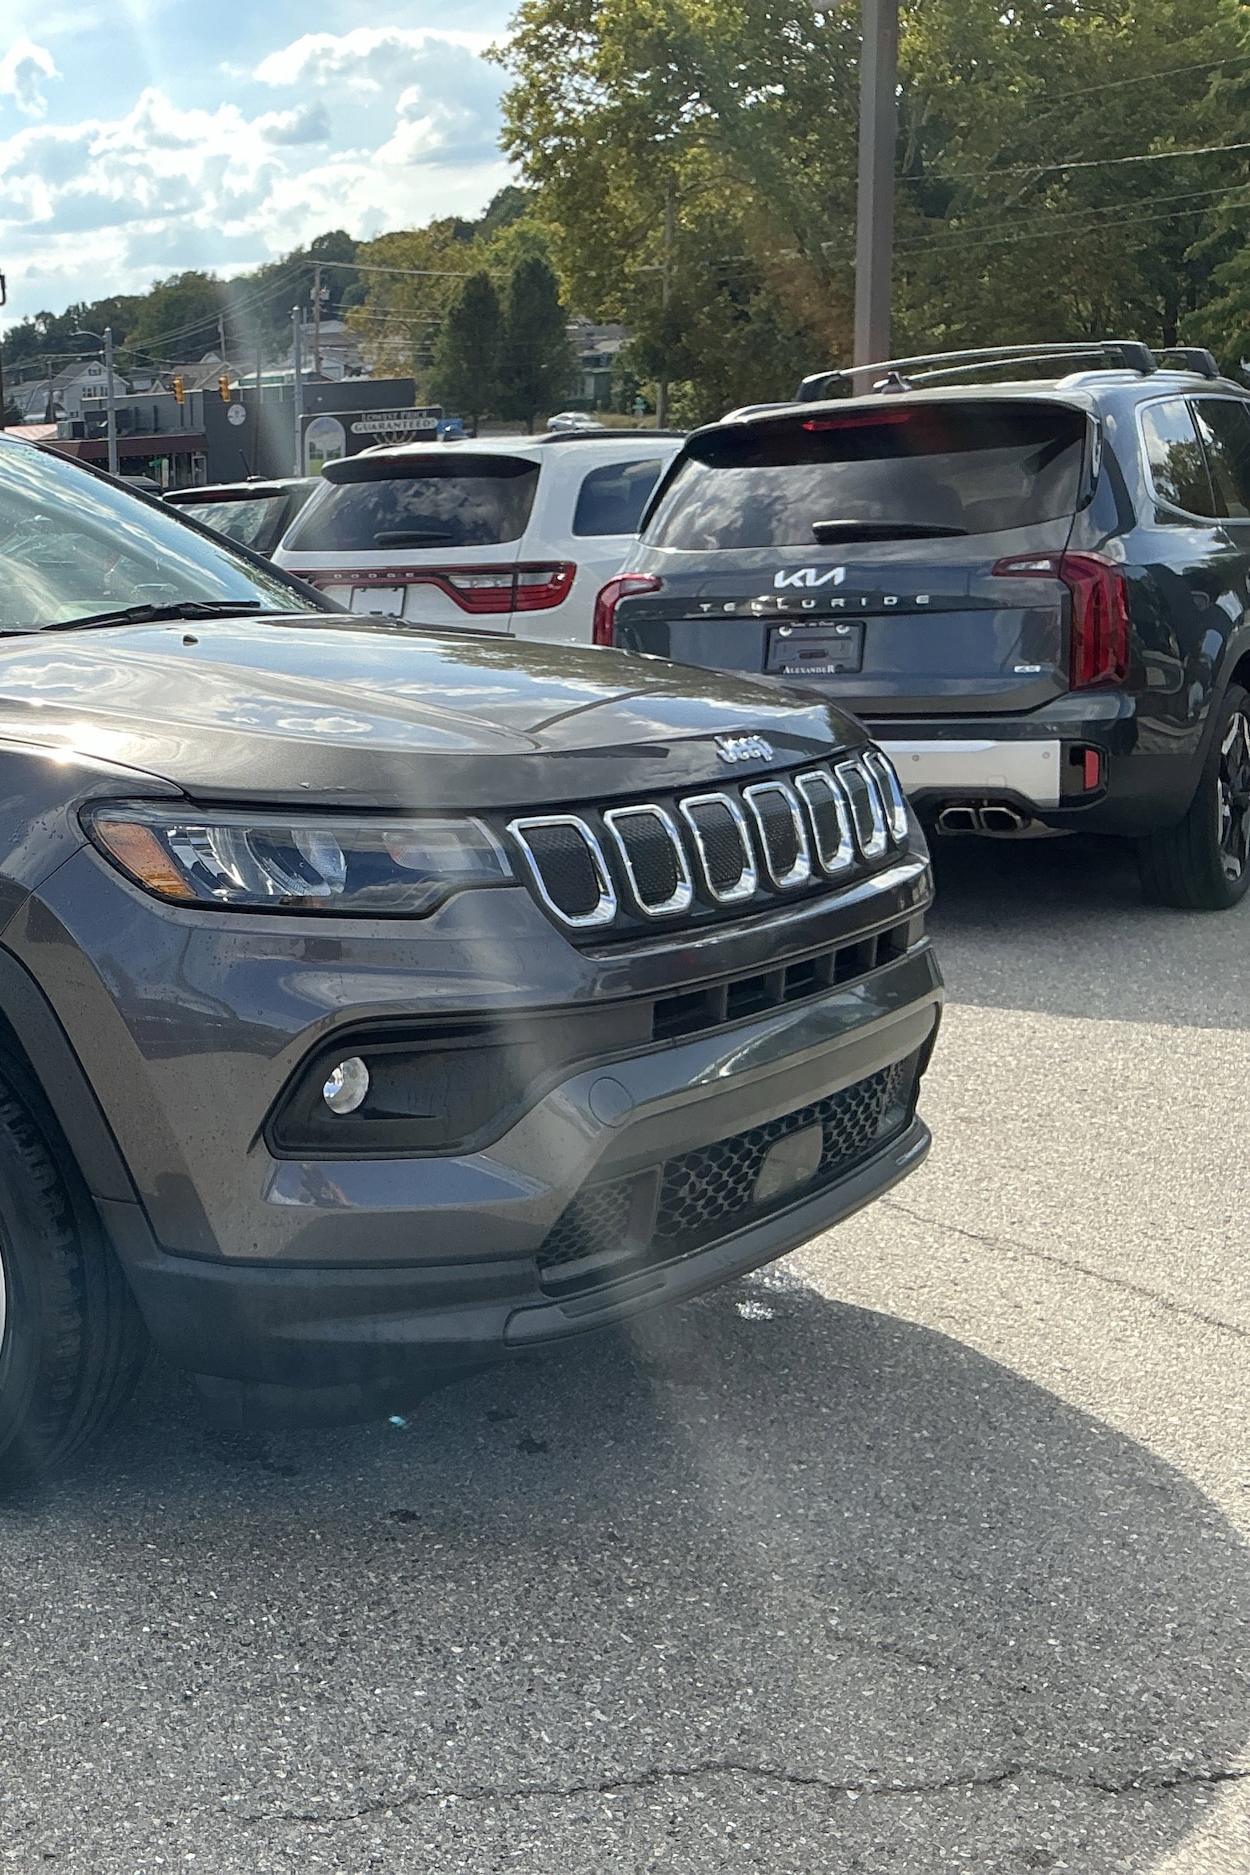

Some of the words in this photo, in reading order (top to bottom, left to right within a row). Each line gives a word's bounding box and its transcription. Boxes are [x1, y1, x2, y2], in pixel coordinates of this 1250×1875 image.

[699, 595, 930, 613] TELLURIDE
[783, 664, 835, 674] ALEXANDER
[714, 734, 774, 764] Jeep
